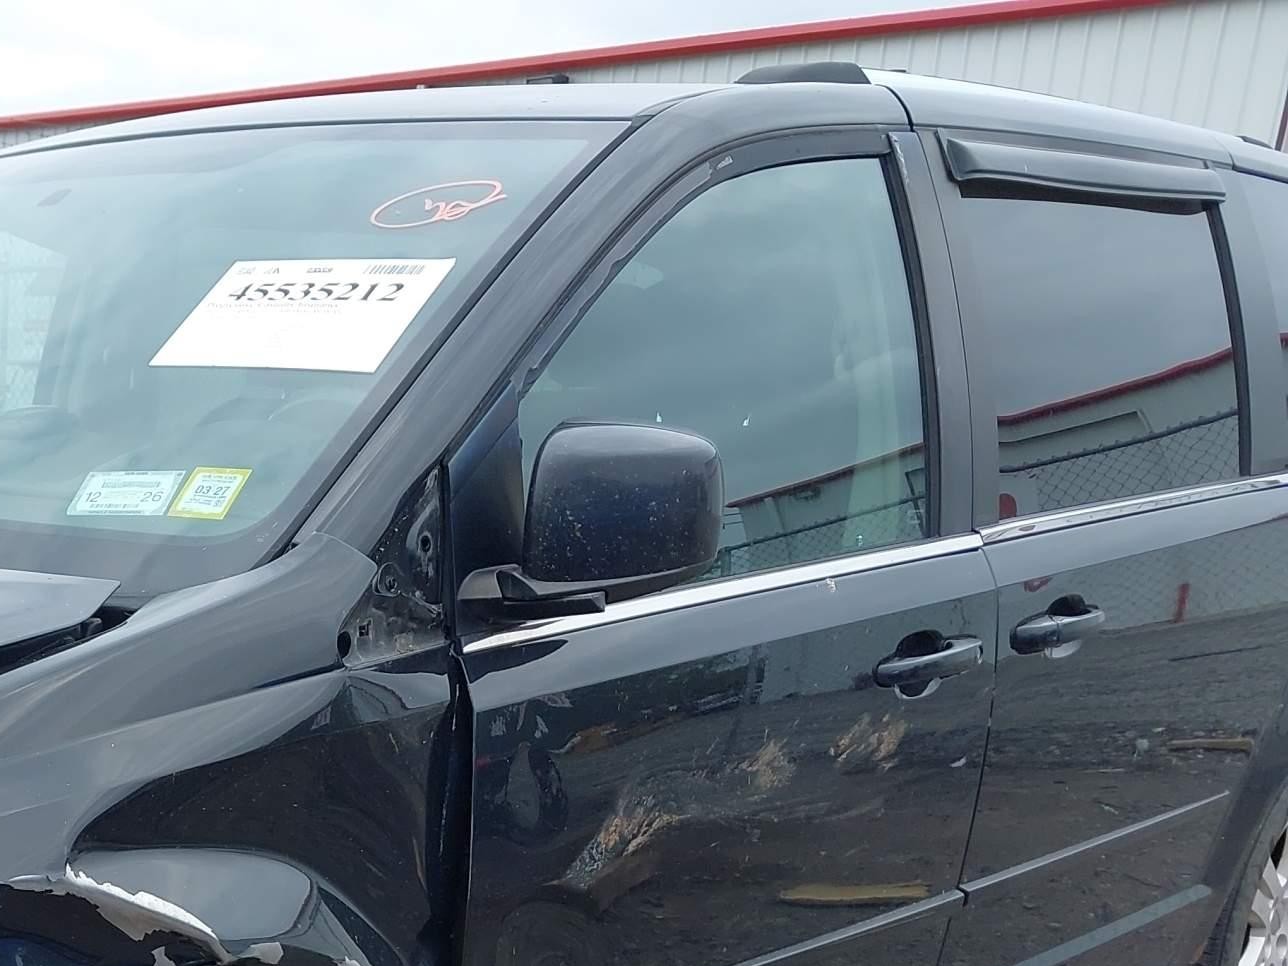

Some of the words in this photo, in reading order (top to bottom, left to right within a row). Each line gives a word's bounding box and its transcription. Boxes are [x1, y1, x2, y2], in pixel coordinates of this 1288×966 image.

[227, 282, 406, 302] 45535212
[194, 484, 212, 495] 03
[213, 486, 231, 496] 27
[85, 491, 102, 503] 12
[140, 491, 164, 502] 26
